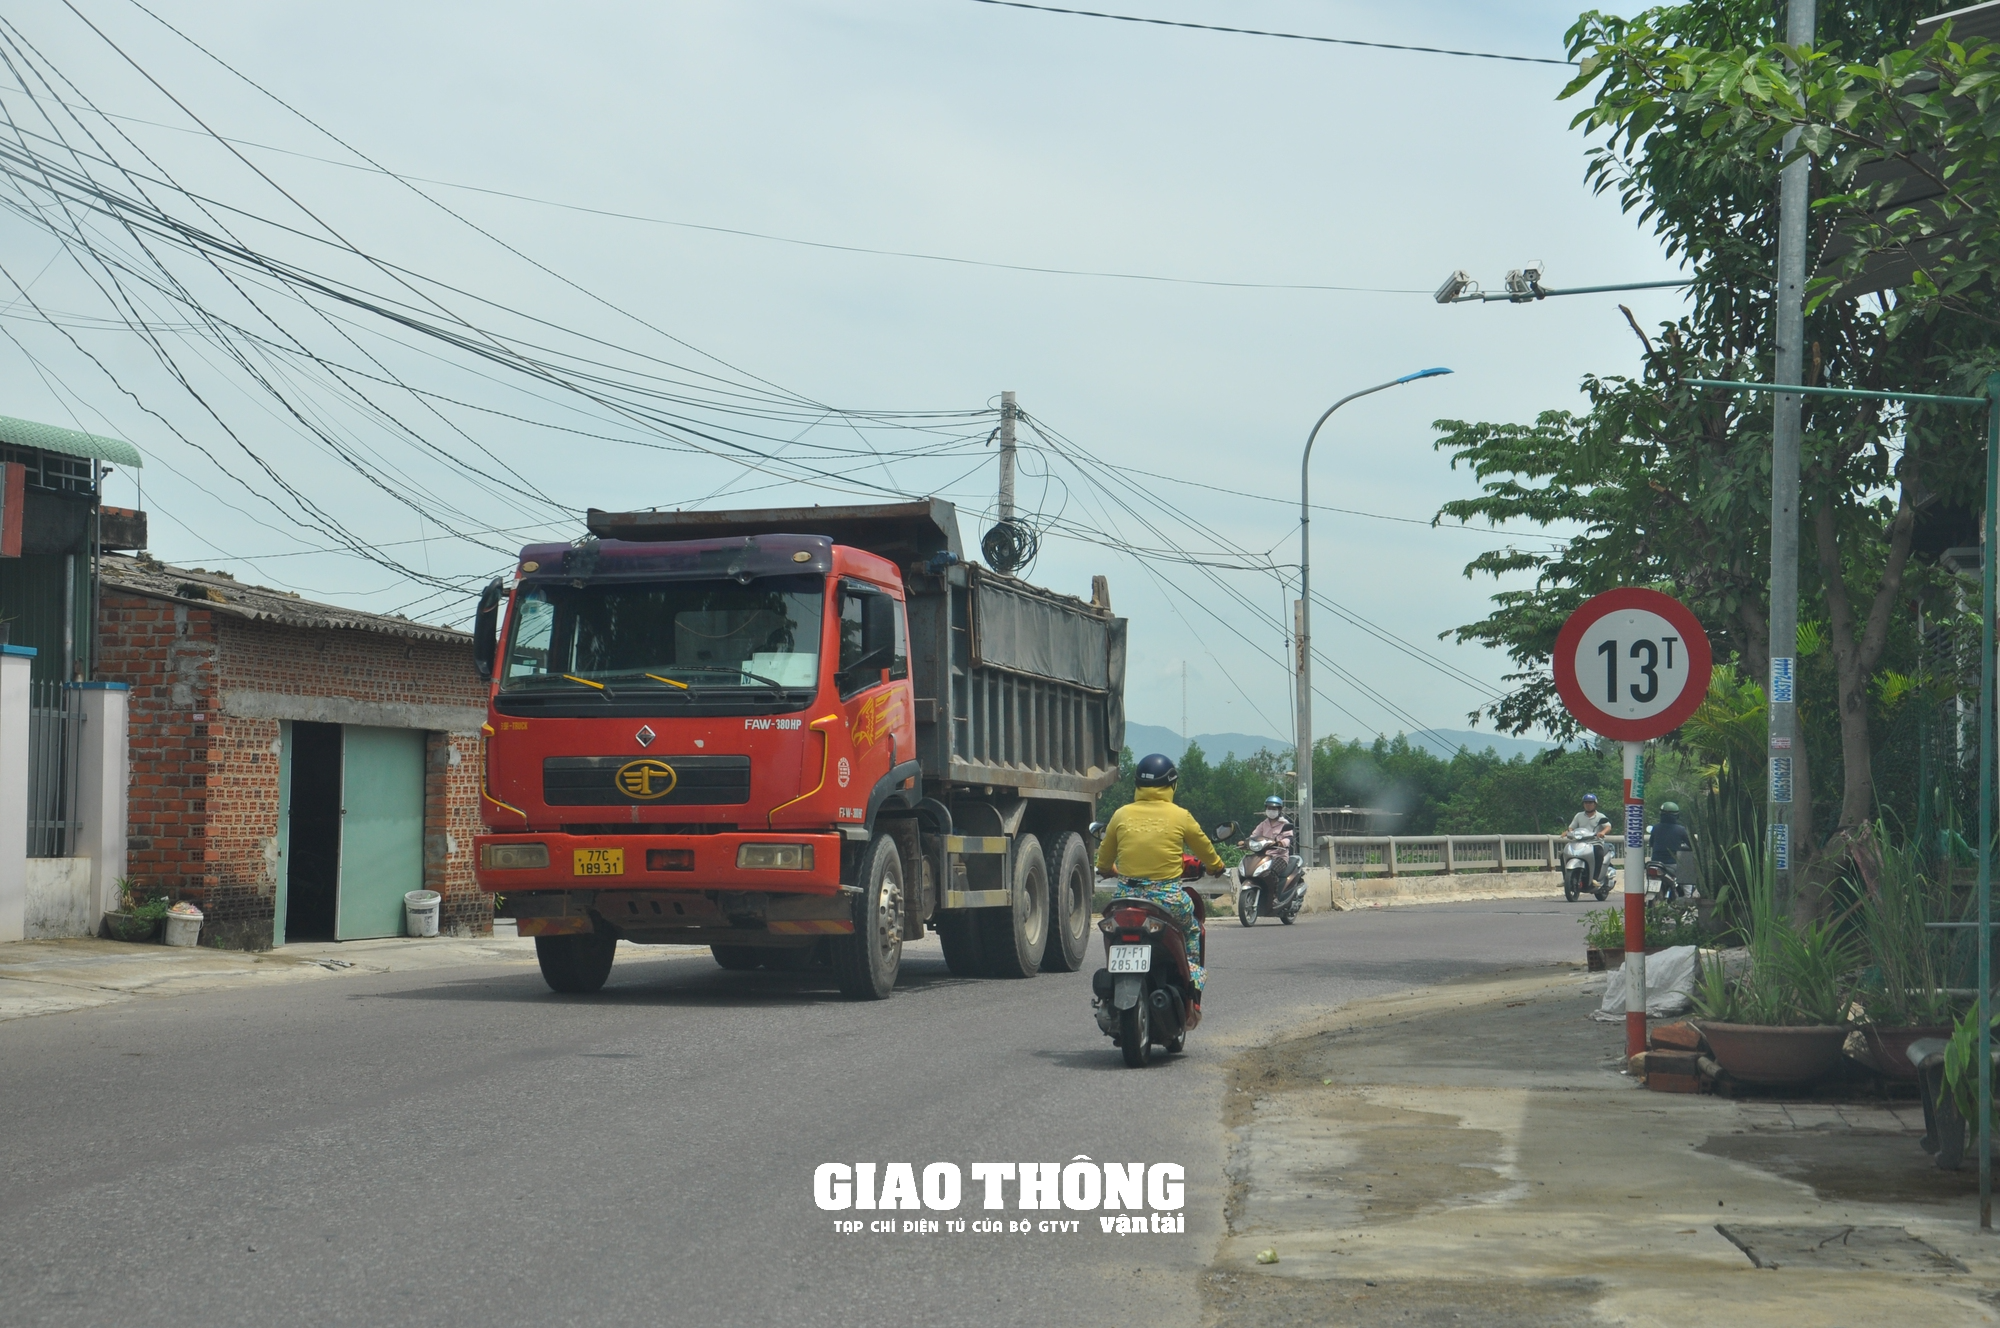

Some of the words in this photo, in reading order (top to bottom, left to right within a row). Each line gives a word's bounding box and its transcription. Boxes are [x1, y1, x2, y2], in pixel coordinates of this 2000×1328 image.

[587, 850, 609, 861] 77C
[580, 862, 617, 874] 189.31
[1116, 947, 1144, 958] 77-F1
[1111, 960, 1147, 970] 285.18
